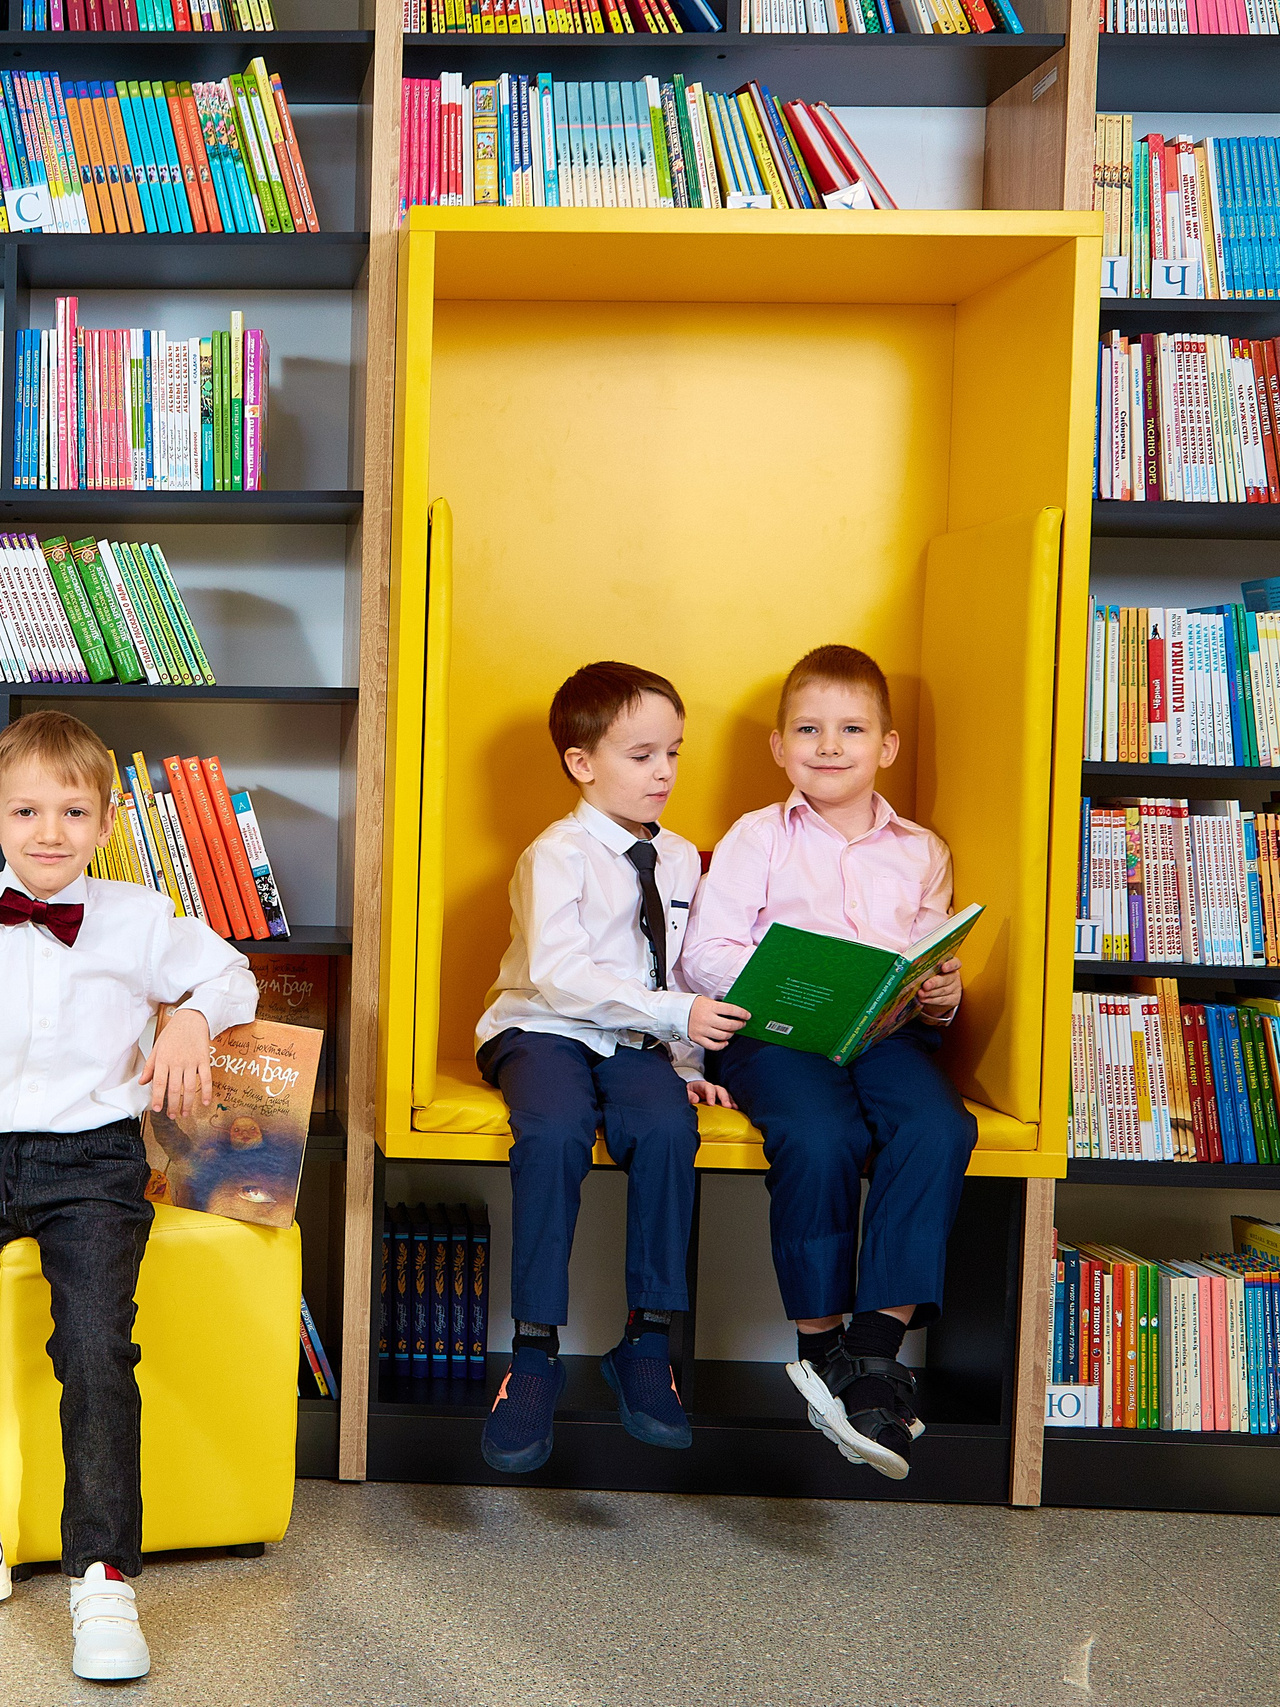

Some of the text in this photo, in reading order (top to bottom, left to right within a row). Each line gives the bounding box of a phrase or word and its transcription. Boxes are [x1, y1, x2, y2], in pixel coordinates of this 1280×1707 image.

[16, 192, 42, 222] С
[1162, 266, 1190, 295] Ч
[1178, 381, 1186, 407] ЗВЕРЕЙ
[1119, 410, 1127, 460] Сибирочка
[1181, 426, 1189, 464] РАССКАЗЫ
[1239, 402, 1249, 445] МУЖЕСТВА
[1147, 418, 1157, 485] ТАСИНО ГОРЕ
[42, 568, 76, 649] Стихи русских поэтов
[1172, 641, 1185, 713] КАШТАНКА
[216, 789, 259, 920] АЛЕКСЕЙ ТОЛСТОЙ СКАЗКИ
[1145, 863, 1153, 914] ПОТЕРЯННОМ
[1250, 881, 1261, 944] ЕВГЕНИЙ ШВАРЦ
[259, 1054, 300, 1097] Бада
[1108, 1107, 1116, 1152] ШКОЛЬНЫЕ
[1046, 1393, 1081, 1418] Ю
